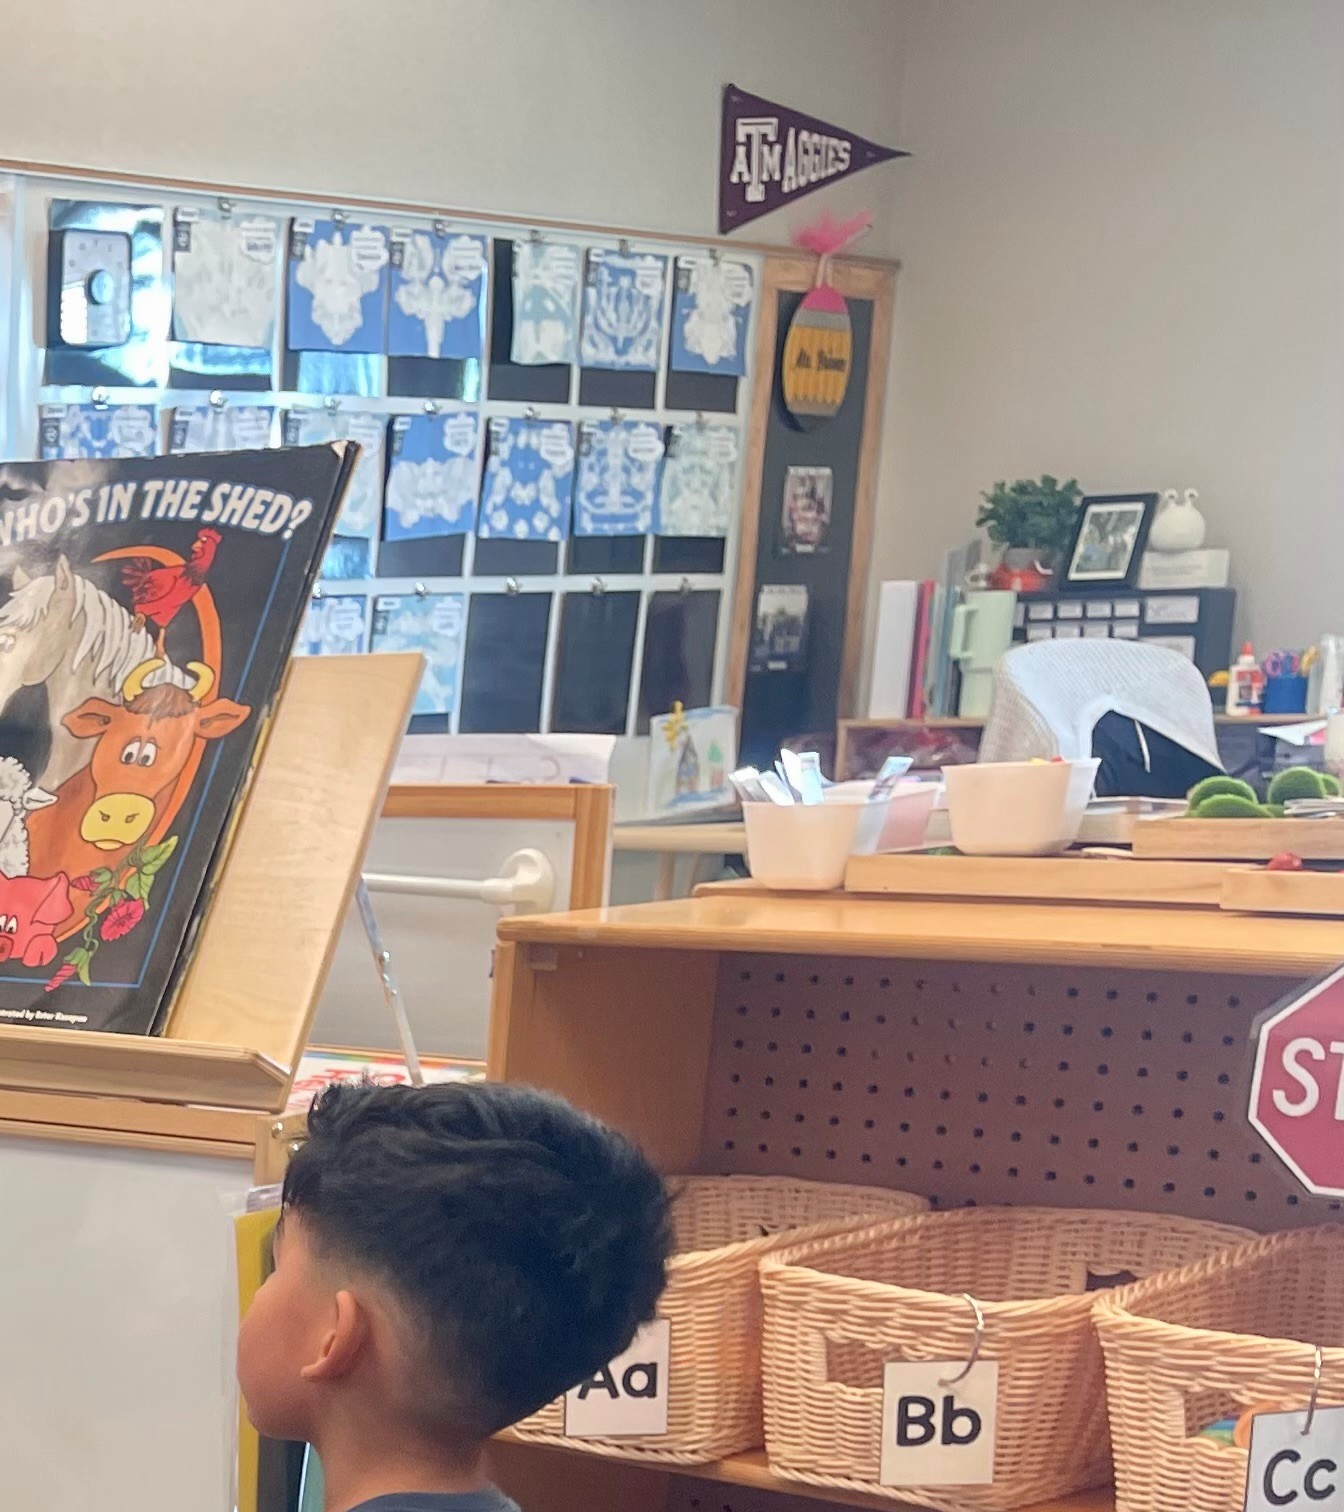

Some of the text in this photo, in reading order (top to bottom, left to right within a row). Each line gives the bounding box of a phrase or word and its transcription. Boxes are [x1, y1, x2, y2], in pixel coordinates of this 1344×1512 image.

[96, 482, 136, 523] IN
[141, 478, 210, 521] THE
[201, 481, 313, 540] SHED?
[896, 1396, 981, 1447] Bb
[1263, 1449, 1337, 1506] Cc
